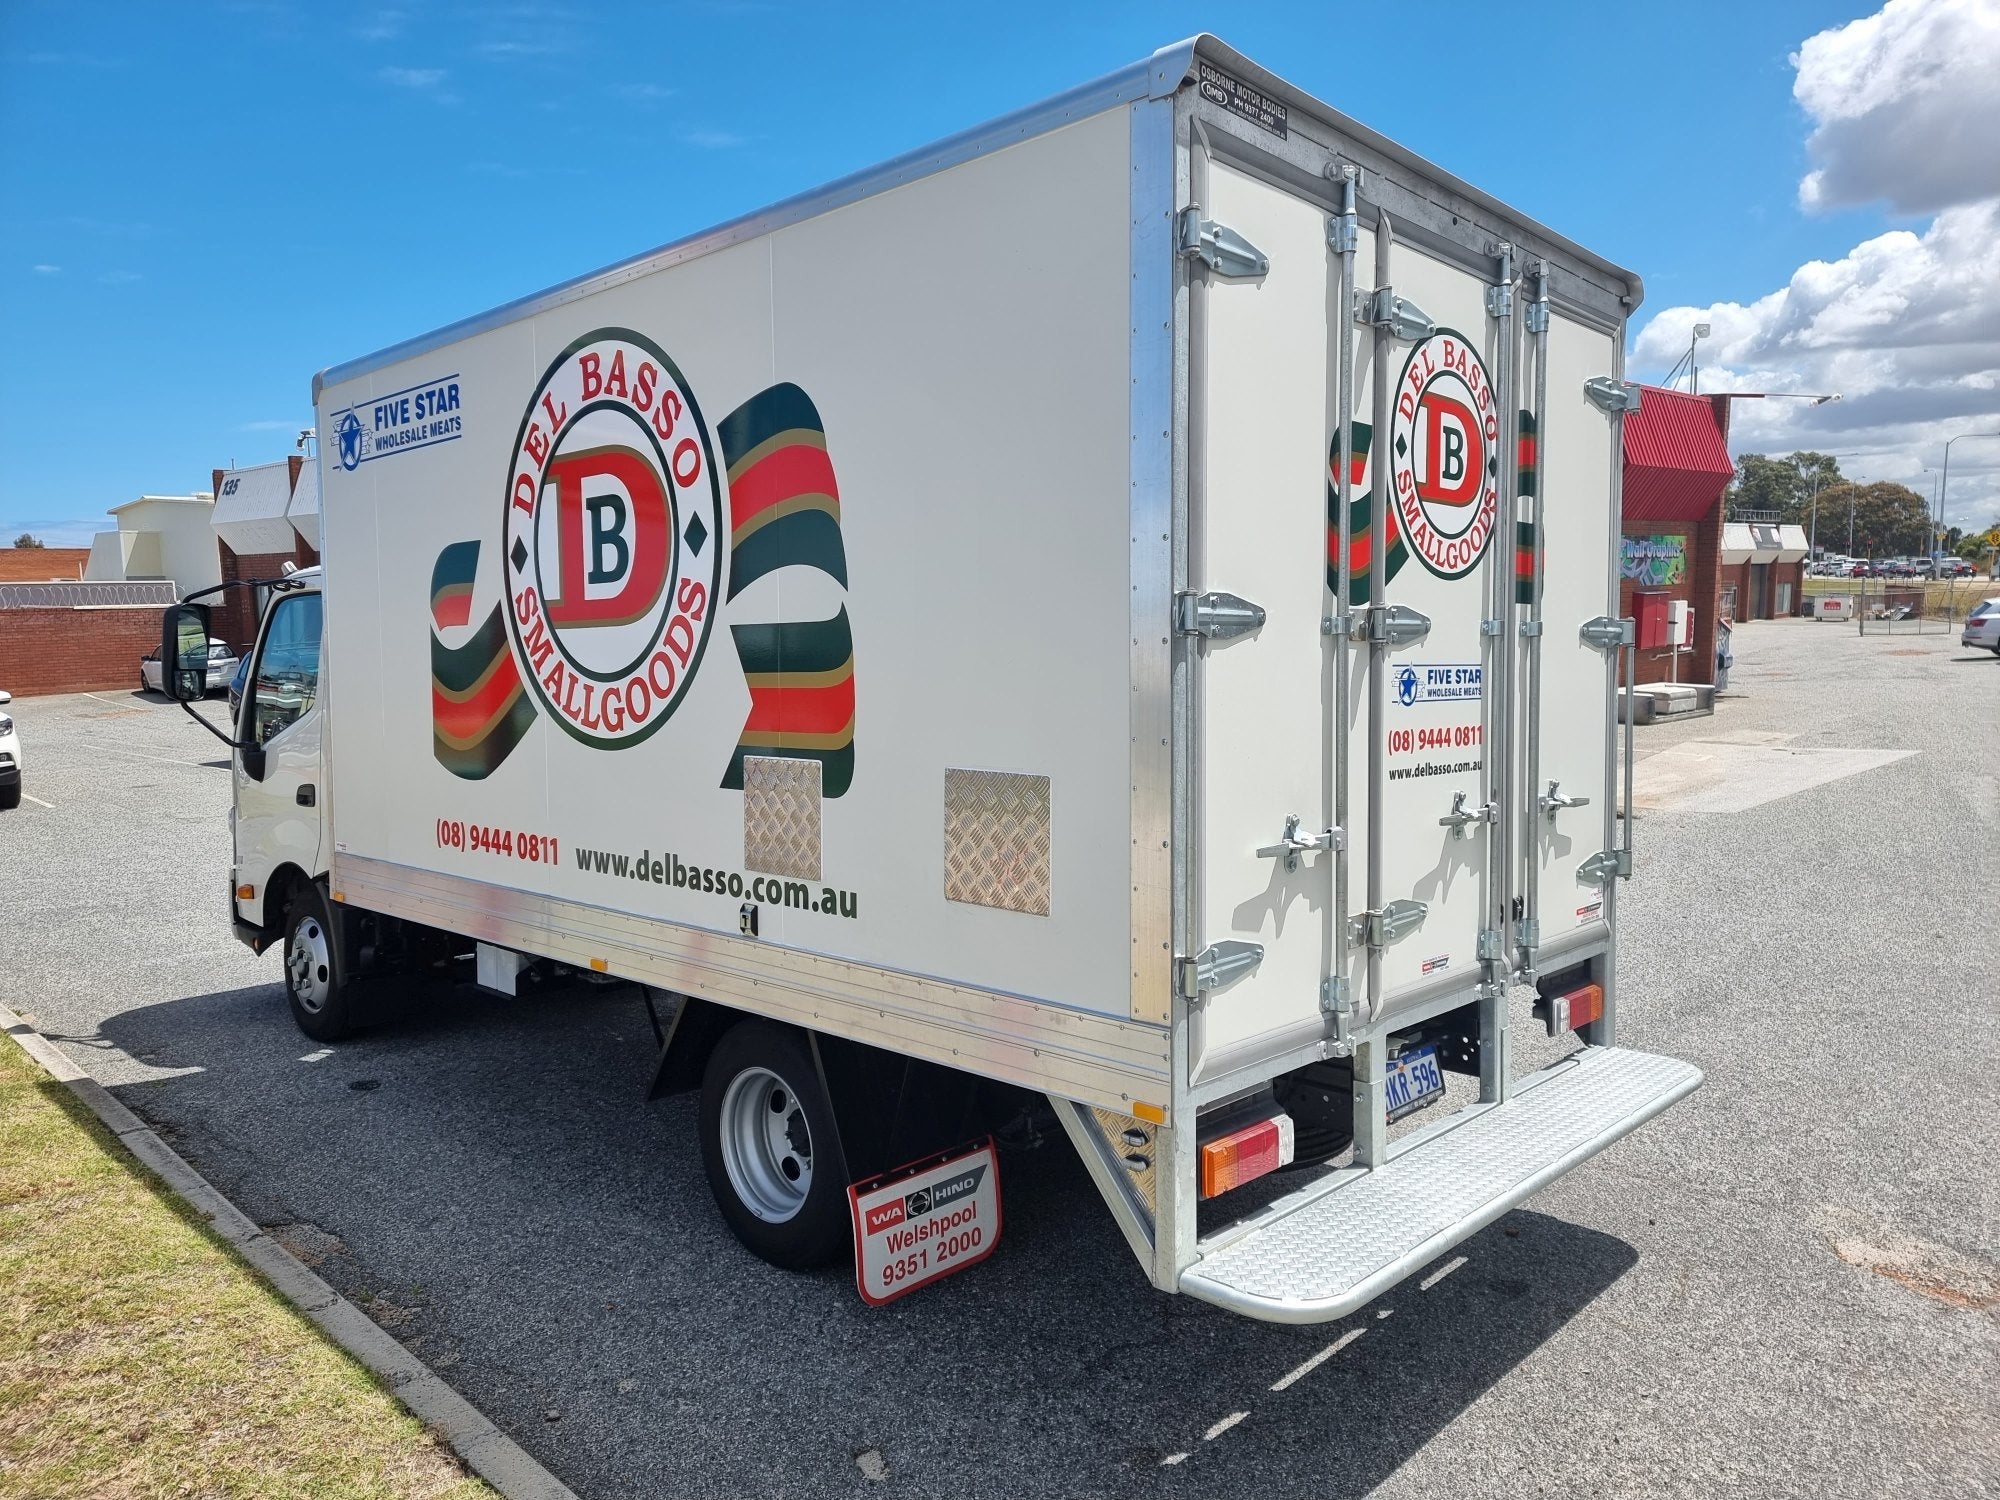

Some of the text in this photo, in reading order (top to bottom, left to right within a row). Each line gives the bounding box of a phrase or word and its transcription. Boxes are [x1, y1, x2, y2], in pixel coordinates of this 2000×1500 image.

[1201, 65, 1286, 120] OSBORNE MOTOR BODIES
[1234, 97, 1244, 109] PH
[374, 384, 460, 431] FIVE STAR
[1399, 340, 1497, 441] DEL BASSO
[375, 416, 462, 451] WHOLESALE MEATS
[513, 349, 701, 519] DEL BASSO
[1442, 426, 1464, 481] B
[222, 478, 241, 496] 135
[586, 493, 629, 586] B
[1397, 468, 1497, 570] SMALLGOODS
[1626, 541, 1680, 560] Wall Graphics
[515, 577, 706, 733] SMALLGOODS
[1427, 668, 1482, 685] FIVE STAR
[1427, 686, 1482, 698] WHOLESALE MEATS
[1388, 724, 1483, 756] (08) 9444 0811
[1389, 760, 1483, 780] www.delbasso.com.au
[436, 817, 559, 865] (08) 9444 0811
[575, 847, 858, 919] www.delbasso.com.au
[871, 1177, 975, 1225] WA HINO
[886, 1201, 977, 1254] Welshpool
[882, 1226, 982, 1287] 9351 2000
